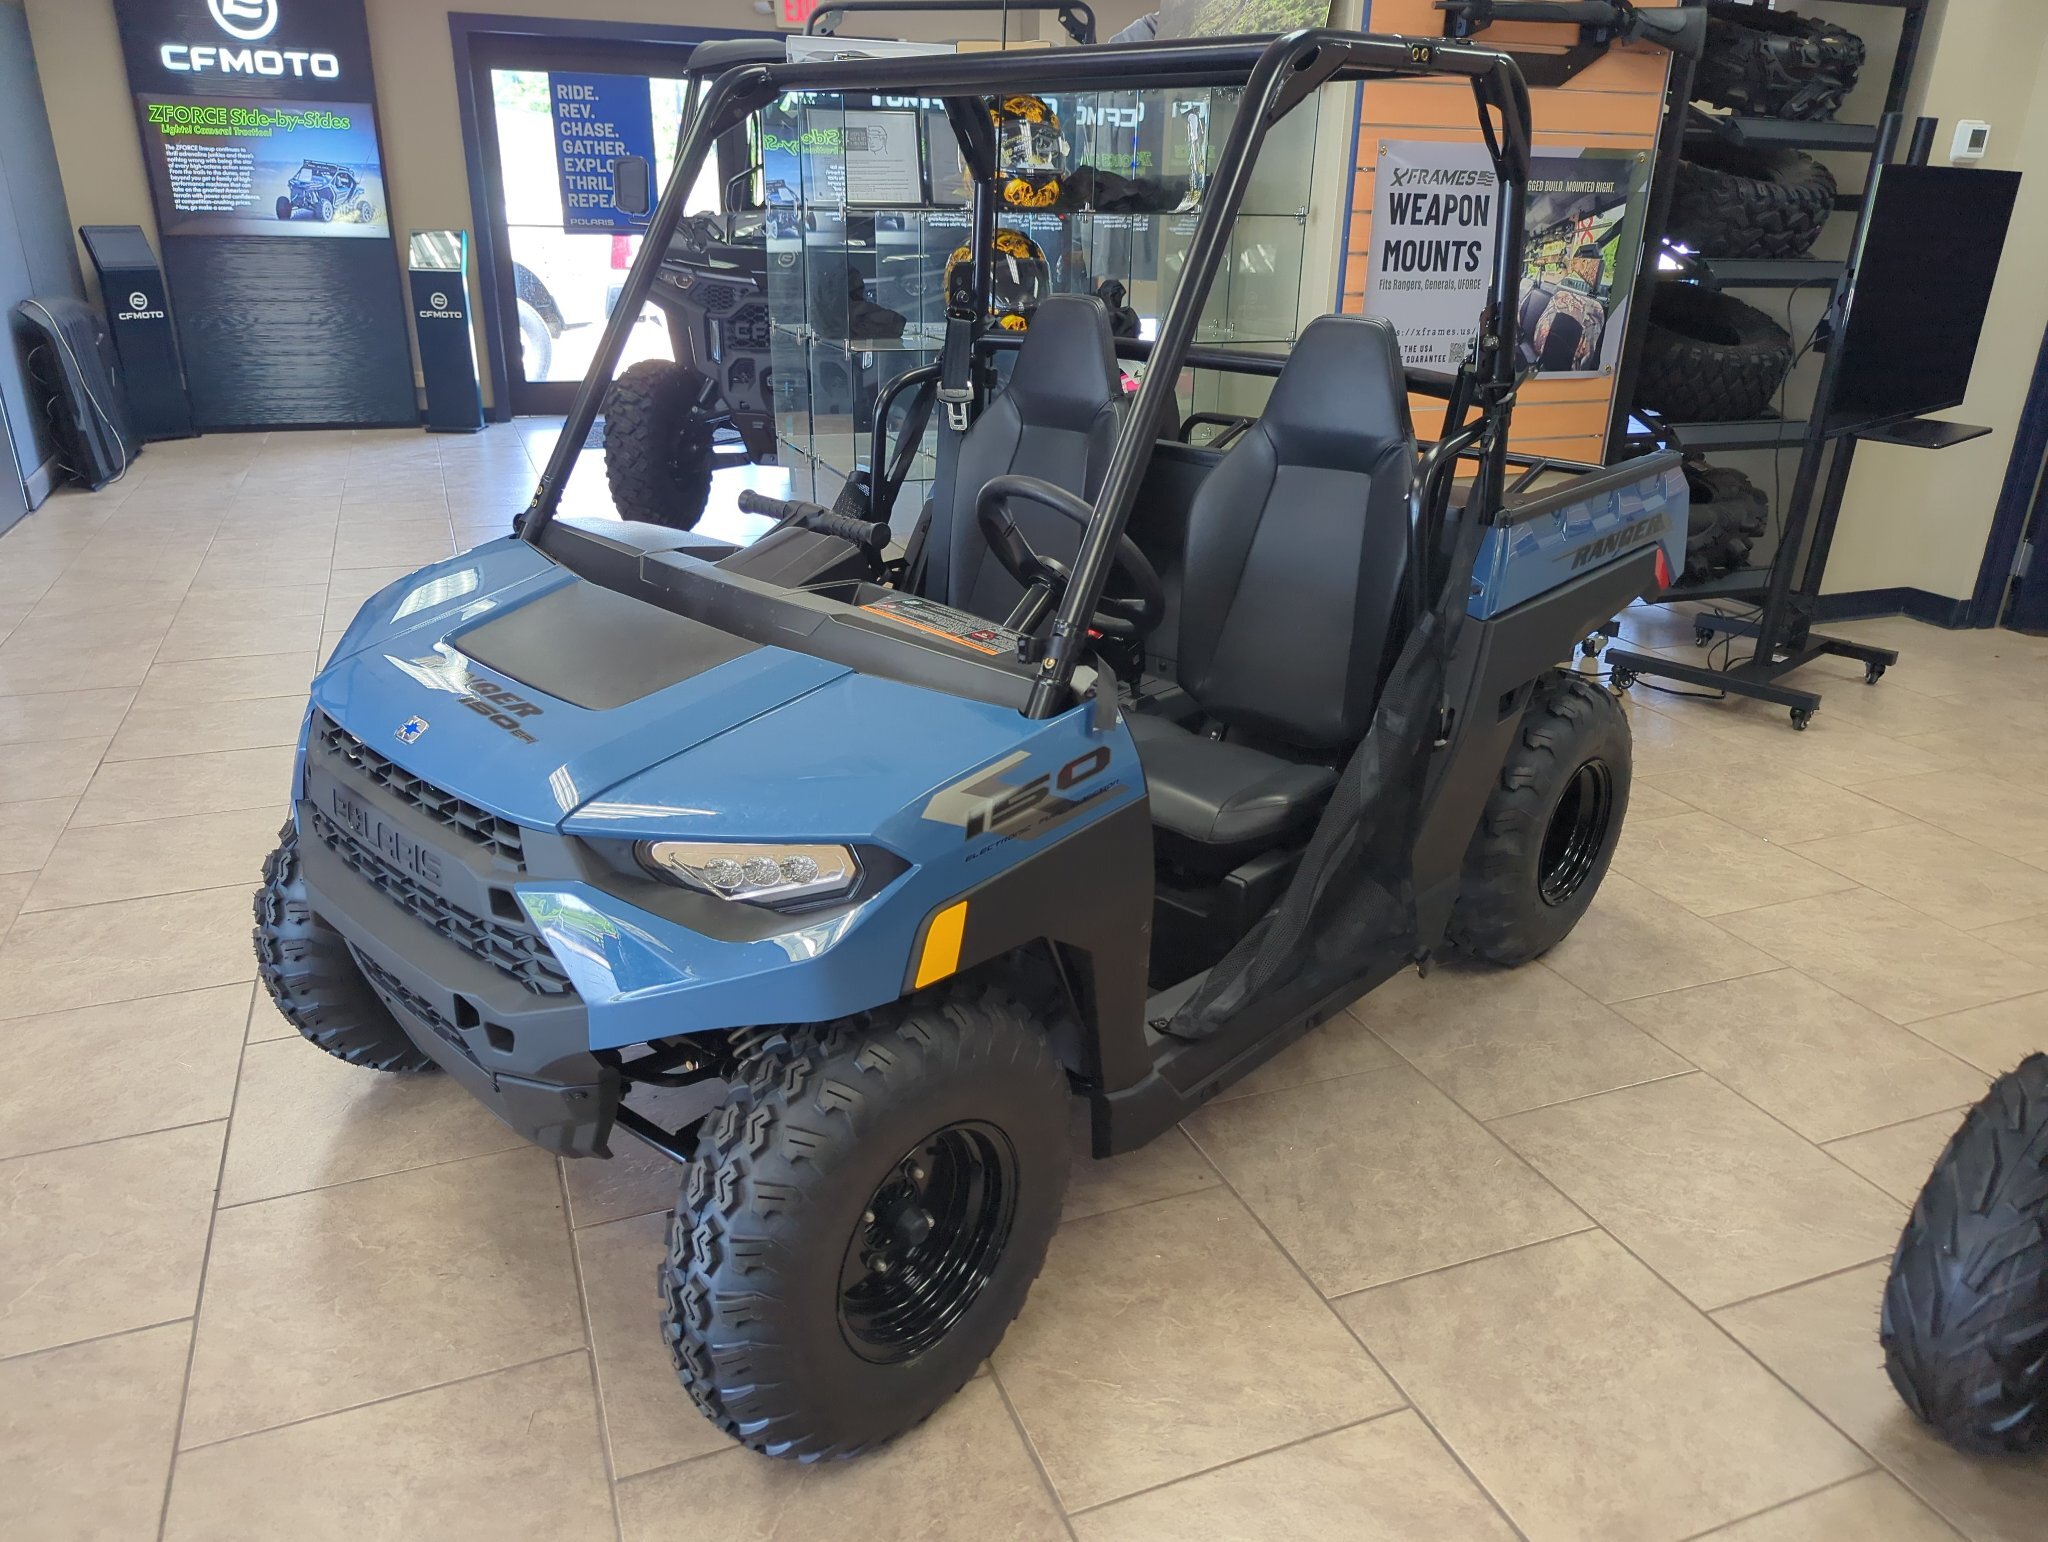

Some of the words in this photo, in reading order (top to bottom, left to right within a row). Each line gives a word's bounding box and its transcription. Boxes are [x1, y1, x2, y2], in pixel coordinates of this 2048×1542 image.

[161, 45, 339, 77] CFMOTO
[557, 84, 599, 100] RIDE.
[148, 105, 226, 125] ZFORCE
[231, 109, 350, 131] Side-by-Sides
[559, 103, 595, 119] REV.
[162, 124, 192, 136] Lights!
[194, 125, 232, 136] Camera!
[233, 127, 272, 137] Traction!
[561, 122, 619, 138] CHASE.
[562, 140, 630, 155] GATHER.
[564, 158, 614, 173] EXPLO
[566, 176, 613, 190] THRIL
[1391, 168, 1478, 186] XFRAMES
[1528, 180, 1543, 191] GGED
[1545, 181, 1564, 192] BUILD.
[1566, 181, 1594, 192] MOUNTED
[1596, 182, 1614, 192] RIGHT.
[568, 193, 616, 208] REPEA
[1390, 193, 1490, 226] WEAPON
[1382, 240, 1481, 272] MOUNTS
[1379, 279, 1391, 290] Fits
[1393, 280, 1423, 291] Rangers,
[1425, 279, 1456, 291] Generals,
[1458, 279, 1481, 290] UFORCE
[119, 311, 164, 320] CFMOTO
[1396, 327, 1476, 336] s://xframes.us/
[1406, 355, 1446, 363] GUARANTEE
[1571, 513, 1663, 570] RANGER
[457, 697, 521, 730] 150
[965, 746, 1111, 841] 150
[333, 788, 443, 887] POLARIS
